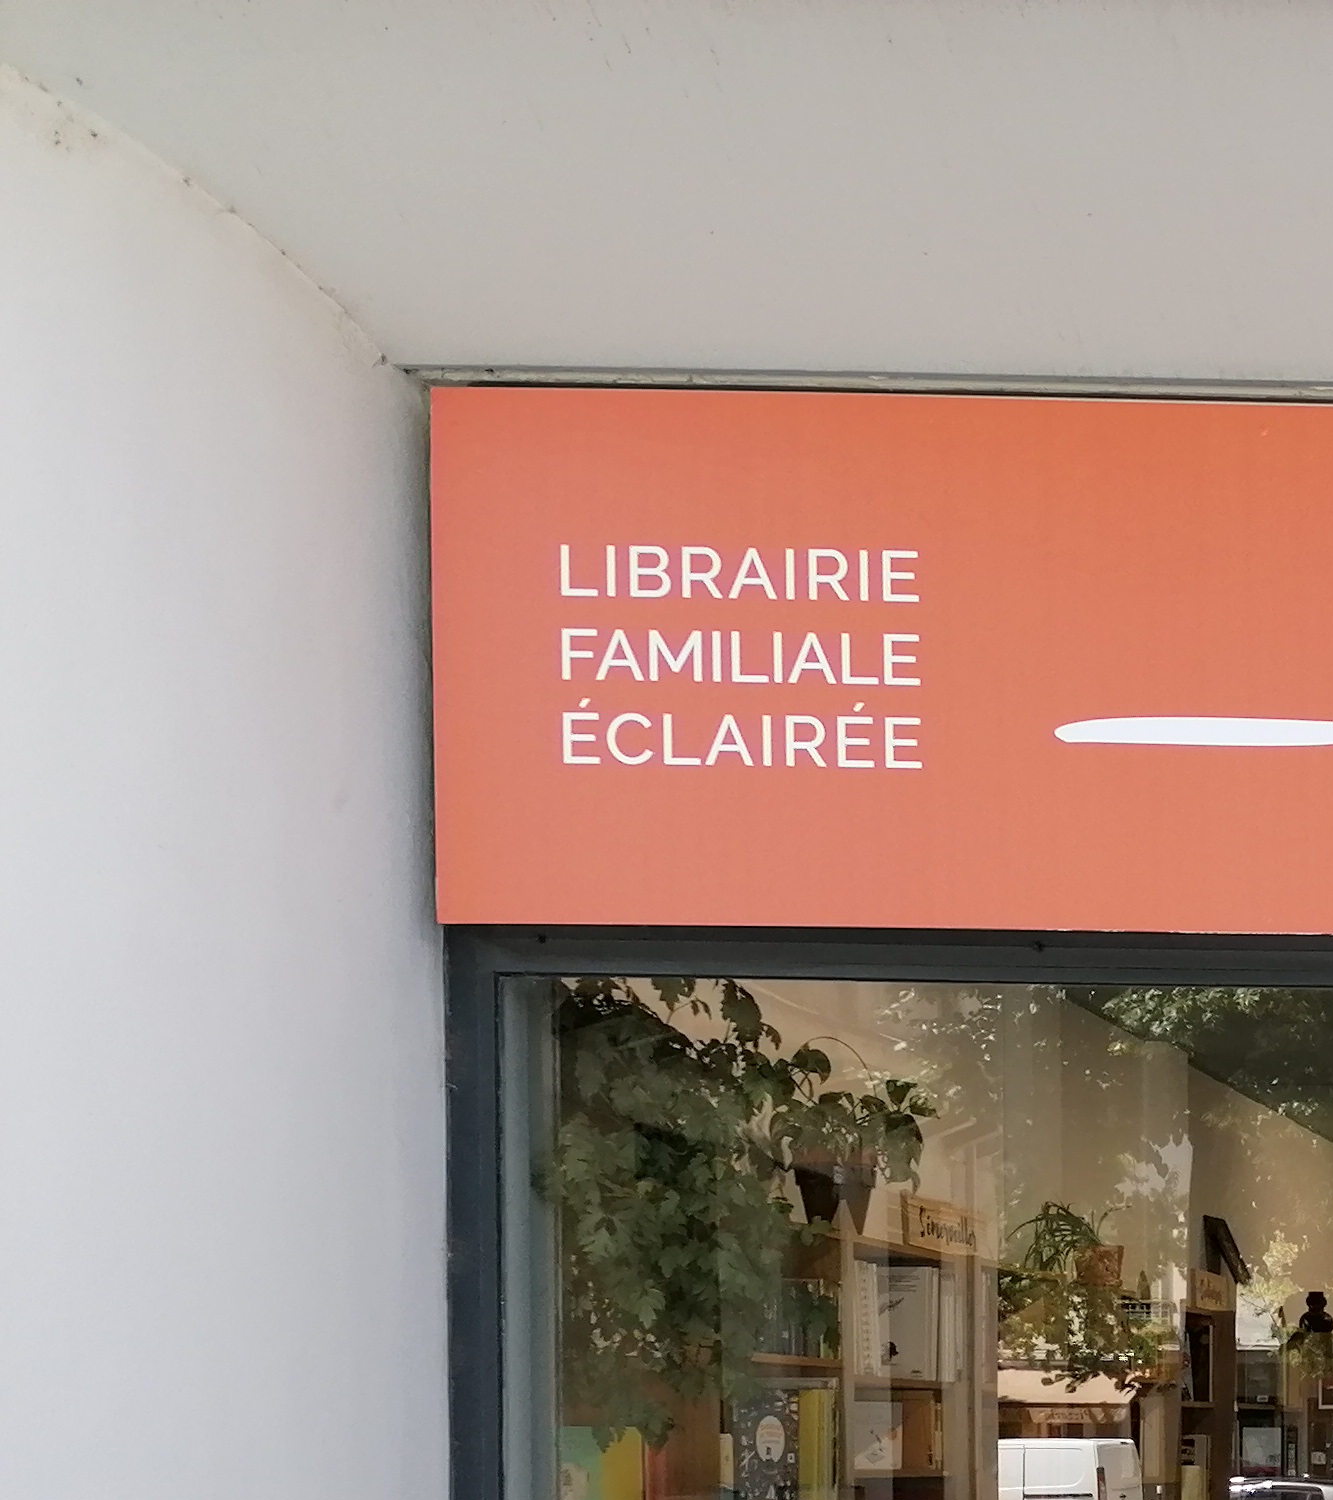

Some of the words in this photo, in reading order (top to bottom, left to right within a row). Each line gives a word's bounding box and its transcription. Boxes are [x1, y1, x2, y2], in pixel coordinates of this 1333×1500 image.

[559, 543, 921, 604] LIBRAIRIE
[559, 627, 922, 687] FAMILIALE
[561, 697, 924, 770] ÉCLAIRÉE
